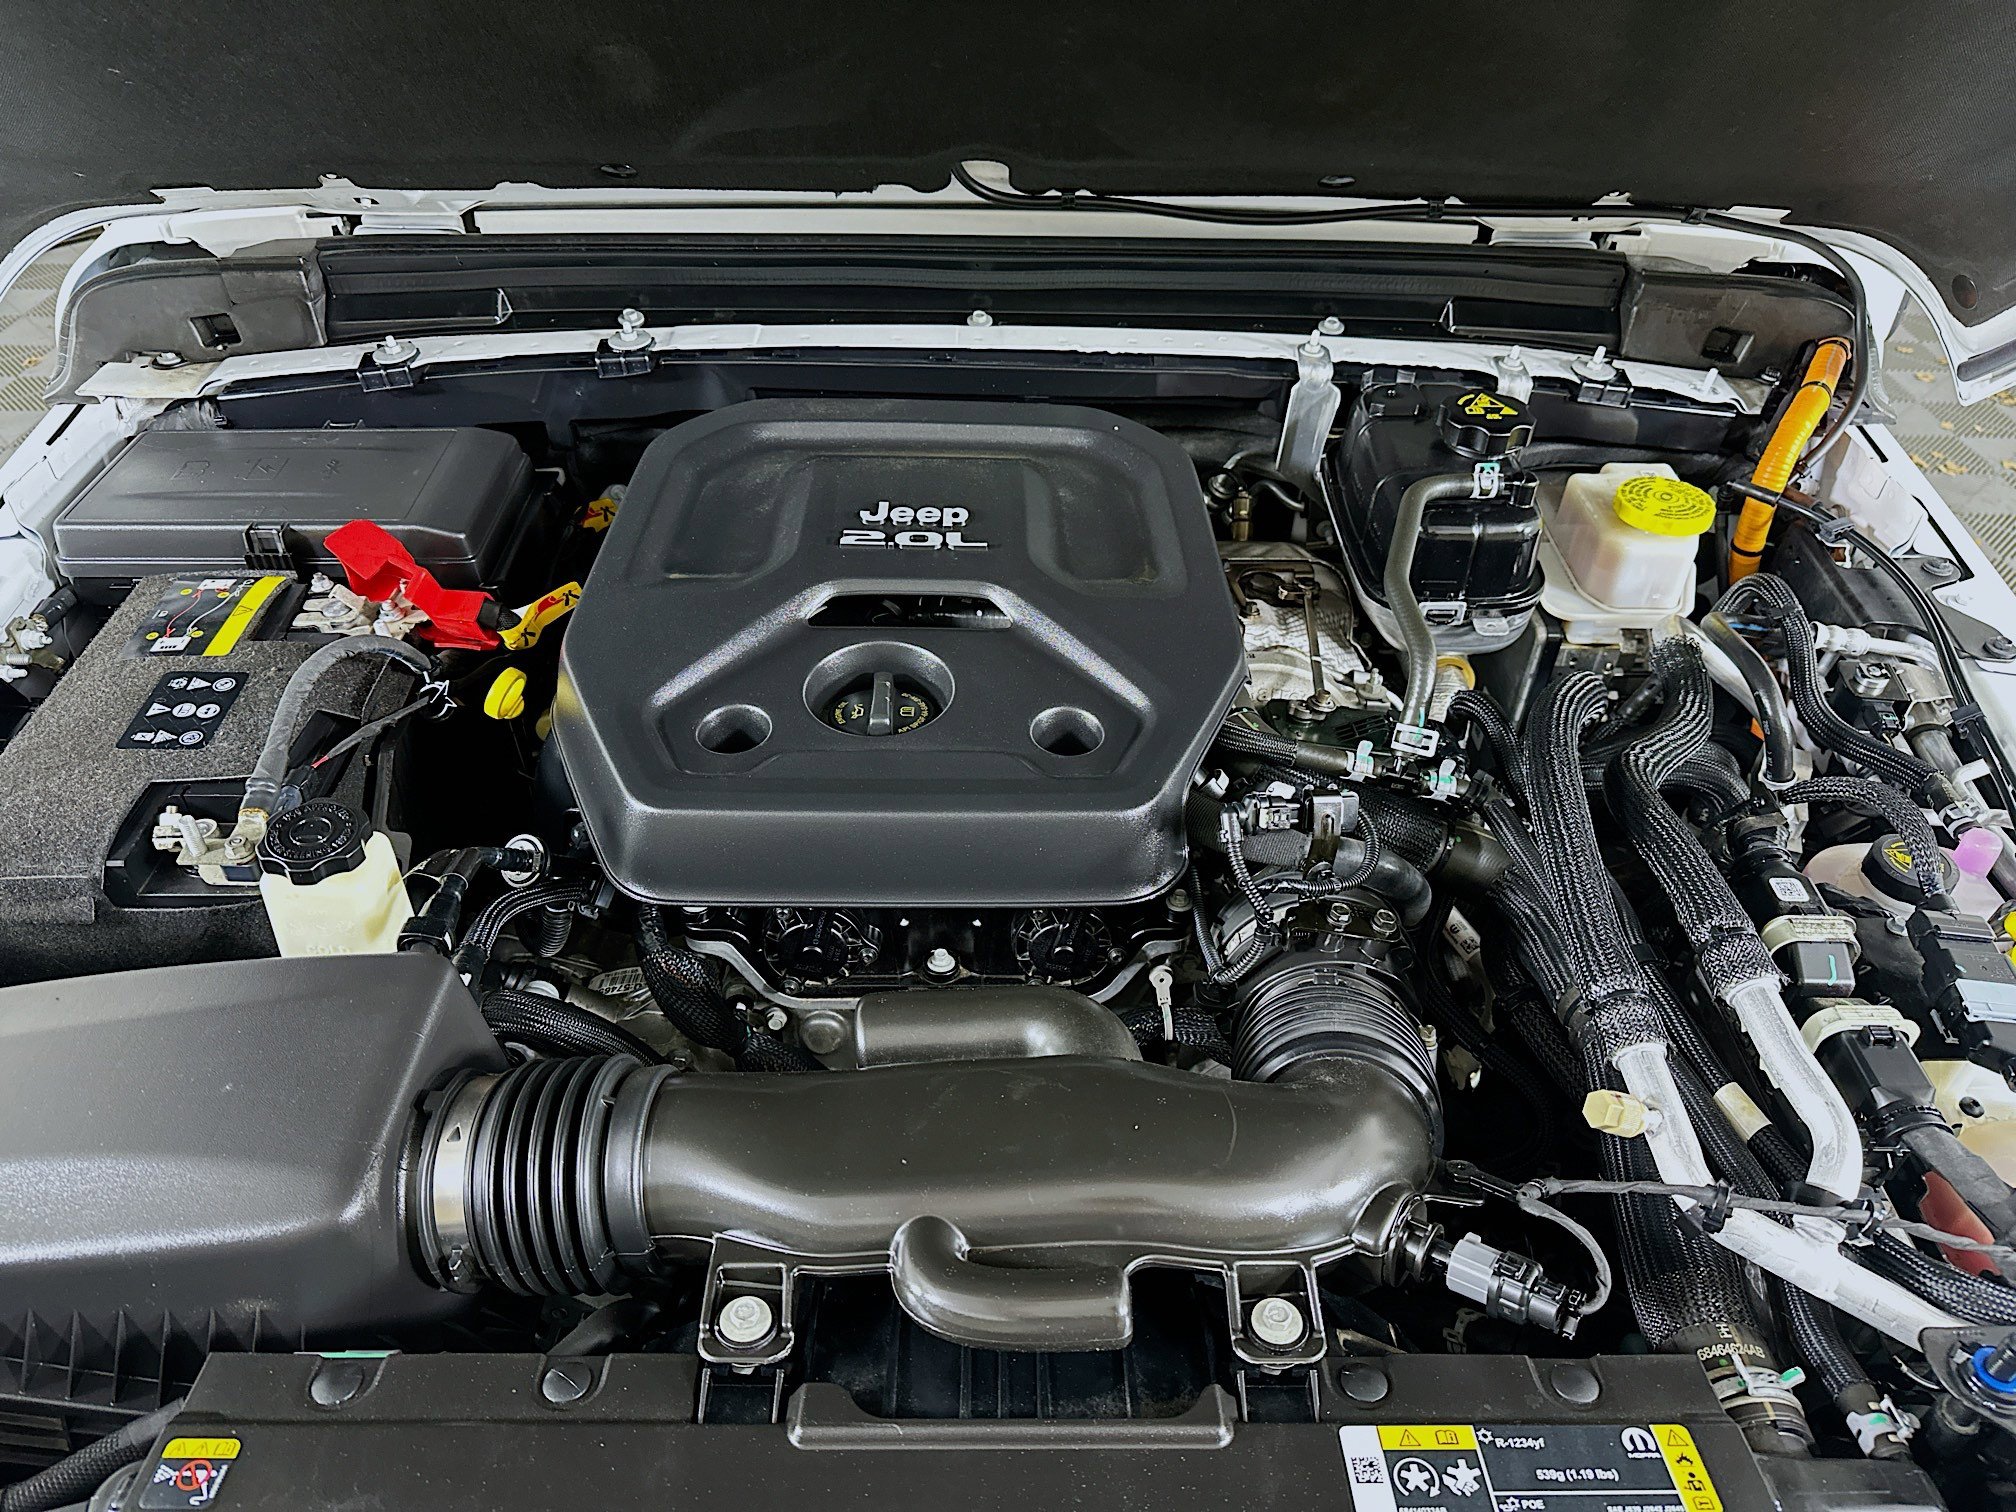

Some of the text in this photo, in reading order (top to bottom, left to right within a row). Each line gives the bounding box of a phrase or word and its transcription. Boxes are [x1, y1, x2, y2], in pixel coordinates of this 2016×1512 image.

[859, 501, 969, 526] Jeep
[839, 529, 988, 549] 2.0L
[1697, 1343, 1765, 1360] 68464624AB
[1494, 1437, 1545, 1451] R-1234yf
[1536, 1468, 1566, 1482] 539g
[1521, 1500, 1545, 1511] POE
